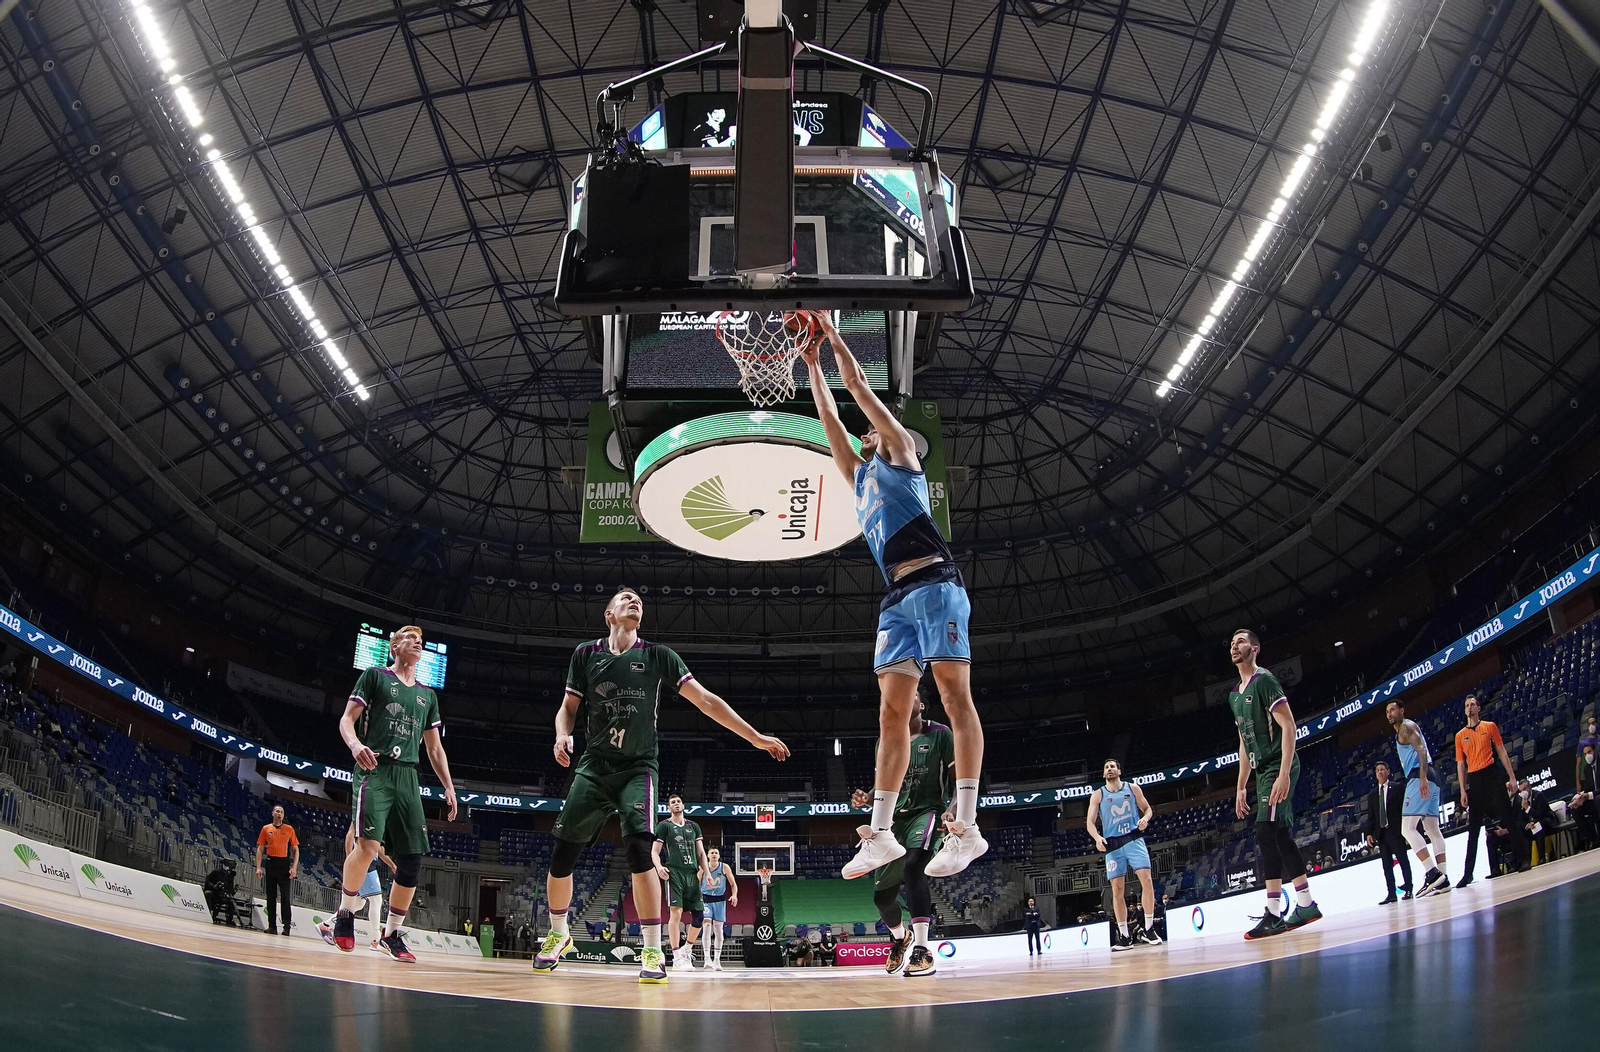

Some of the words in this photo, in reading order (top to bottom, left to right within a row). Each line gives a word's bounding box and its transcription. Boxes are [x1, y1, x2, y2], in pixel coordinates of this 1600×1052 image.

[589, 500, 620, 509] COPA
[778, 477, 817, 541] Unicaja
[1539, 571, 1576, 606] Joma
[0, 608, 21, 633] ma
[1466, 617, 1503, 651] Joma
[69, 652, 102, 680] Joma
[1403, 660, 1433, 686] Joma
[132, 686, 164, 713] Joma
[617, 687, 646, 698] Unicaja
[1335, 699, 1363, 722] Joma
[191, 718, 217, 738] Joma
[609, 727, 626, 748] 21
[258, 746, 289, 765] Joma
[1215, 751, 1240, 769] Jom
[323, 766, 354, 782] Jom
[485, 794, 522, 807] Joma
[979, 794, 1016, 807] Joma
[1054, 785, 1094, 801] Joma
[808, 803, 850, 816] Joma
[40, 863, 71, 880] Unicaja
[105, 880, 133, 896] Unicaja
[181, 898, 205, 912] Unicaja
[576, 952, 606, 962] Unicaja
